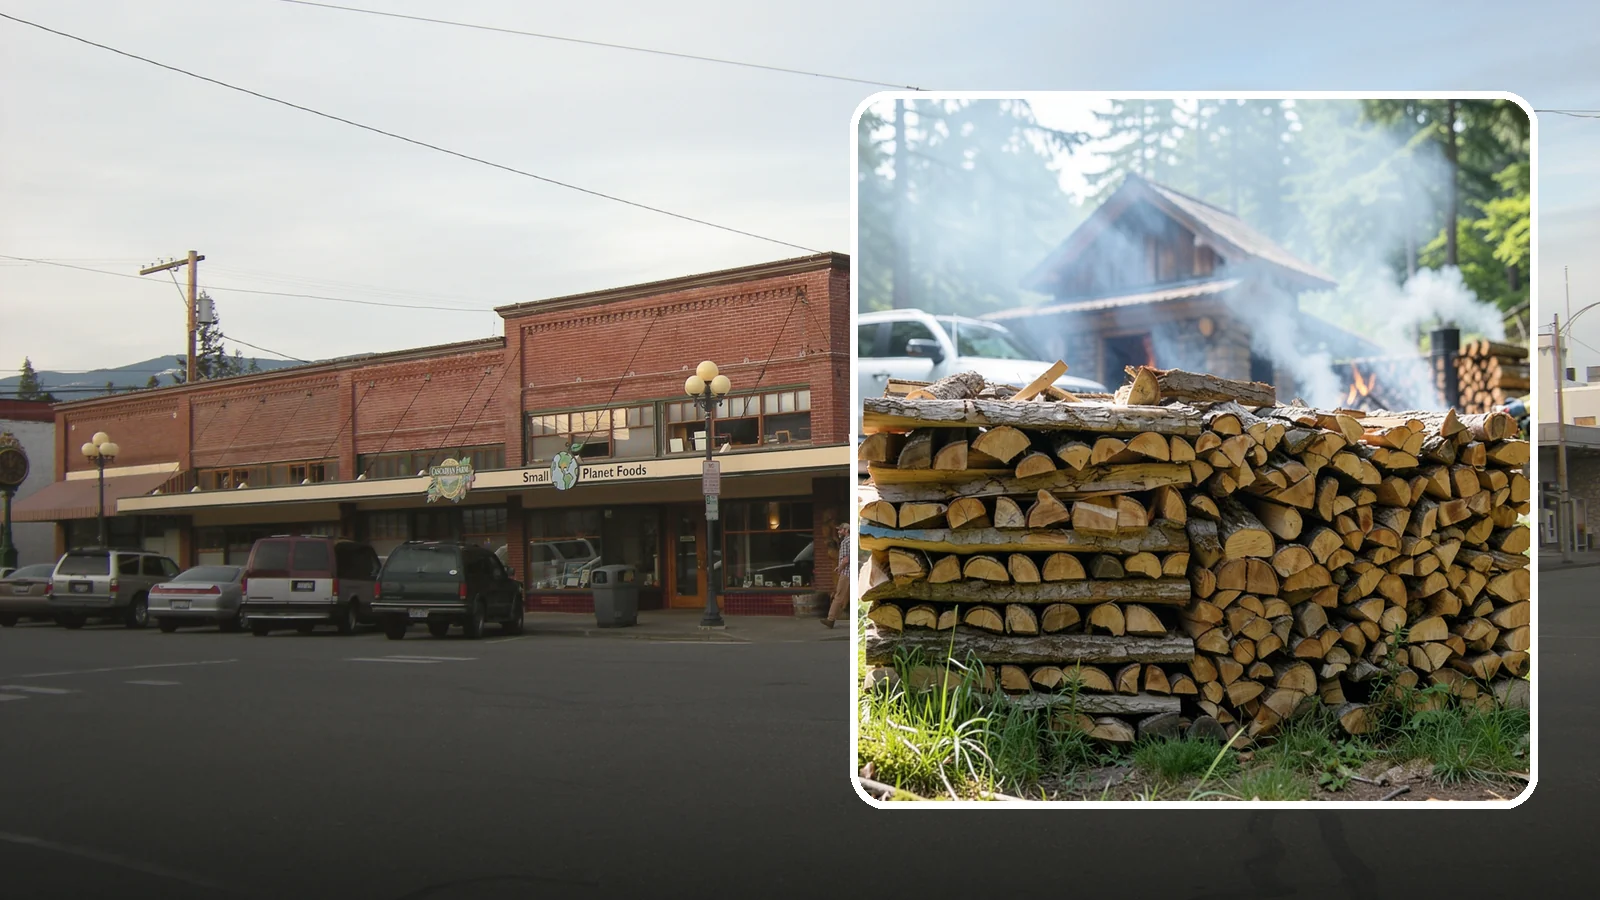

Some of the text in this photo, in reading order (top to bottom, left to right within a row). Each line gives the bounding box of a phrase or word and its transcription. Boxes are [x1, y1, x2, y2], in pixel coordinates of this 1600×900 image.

[523, 464, 646, 482] Small Planet Foods
